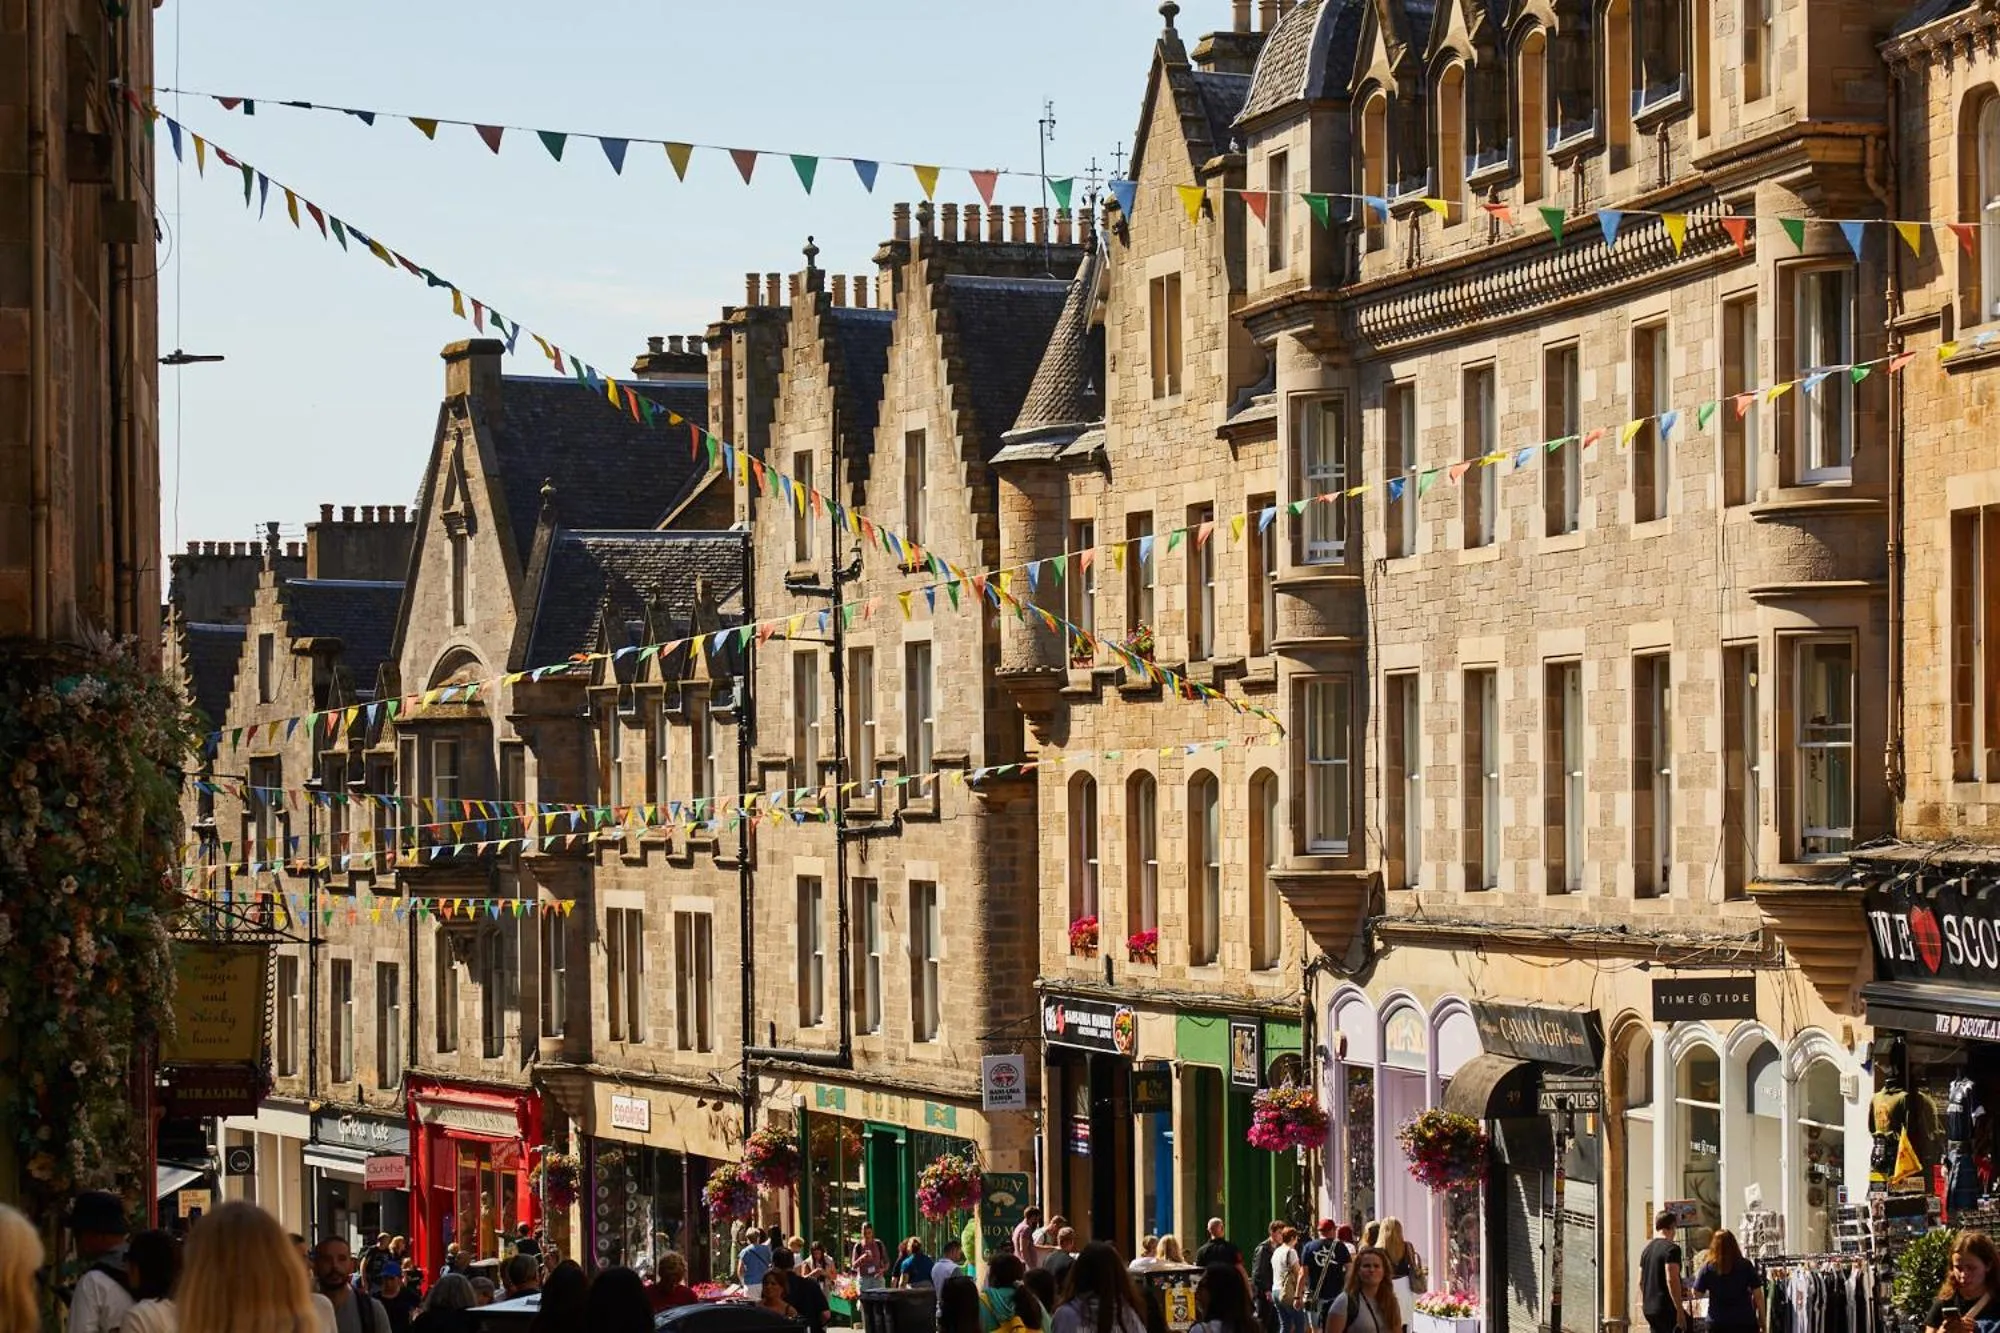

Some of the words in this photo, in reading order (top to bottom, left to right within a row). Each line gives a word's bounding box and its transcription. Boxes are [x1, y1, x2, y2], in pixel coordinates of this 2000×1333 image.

[1867, 910, 1916, 961] WE
[1660, 995, 1695, 1005] TIME
[1715, 993, 1750, 1004] TIDE
[1500, 1016, 1564, 1048] CAVANAGH
[1936, 1014, 1951, 1033] WE
[983, 1225, 1014, 1237] HOM
